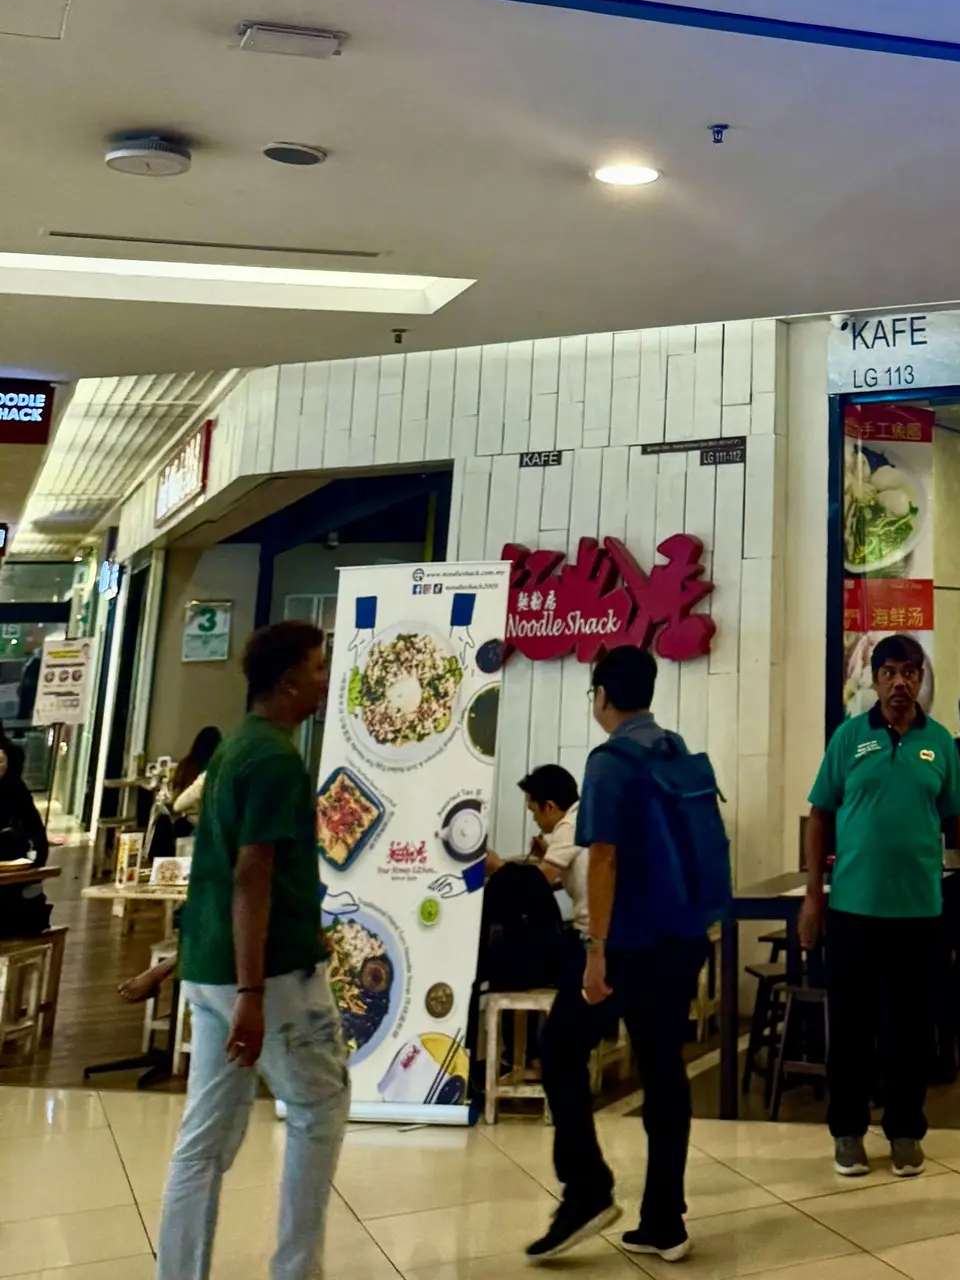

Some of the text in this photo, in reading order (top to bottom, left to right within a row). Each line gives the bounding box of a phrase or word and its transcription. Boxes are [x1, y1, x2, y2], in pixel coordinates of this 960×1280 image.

[852, 316, 927, 351] KAFE
[853, 365, 915, 388] LG 113
[522, 451, 559, 467] KAFE
[703, 450, 742, 464] LG 111-112
[198, 607, 217, 632] 3
[506, 609, 622, 638] Noodle Shack
